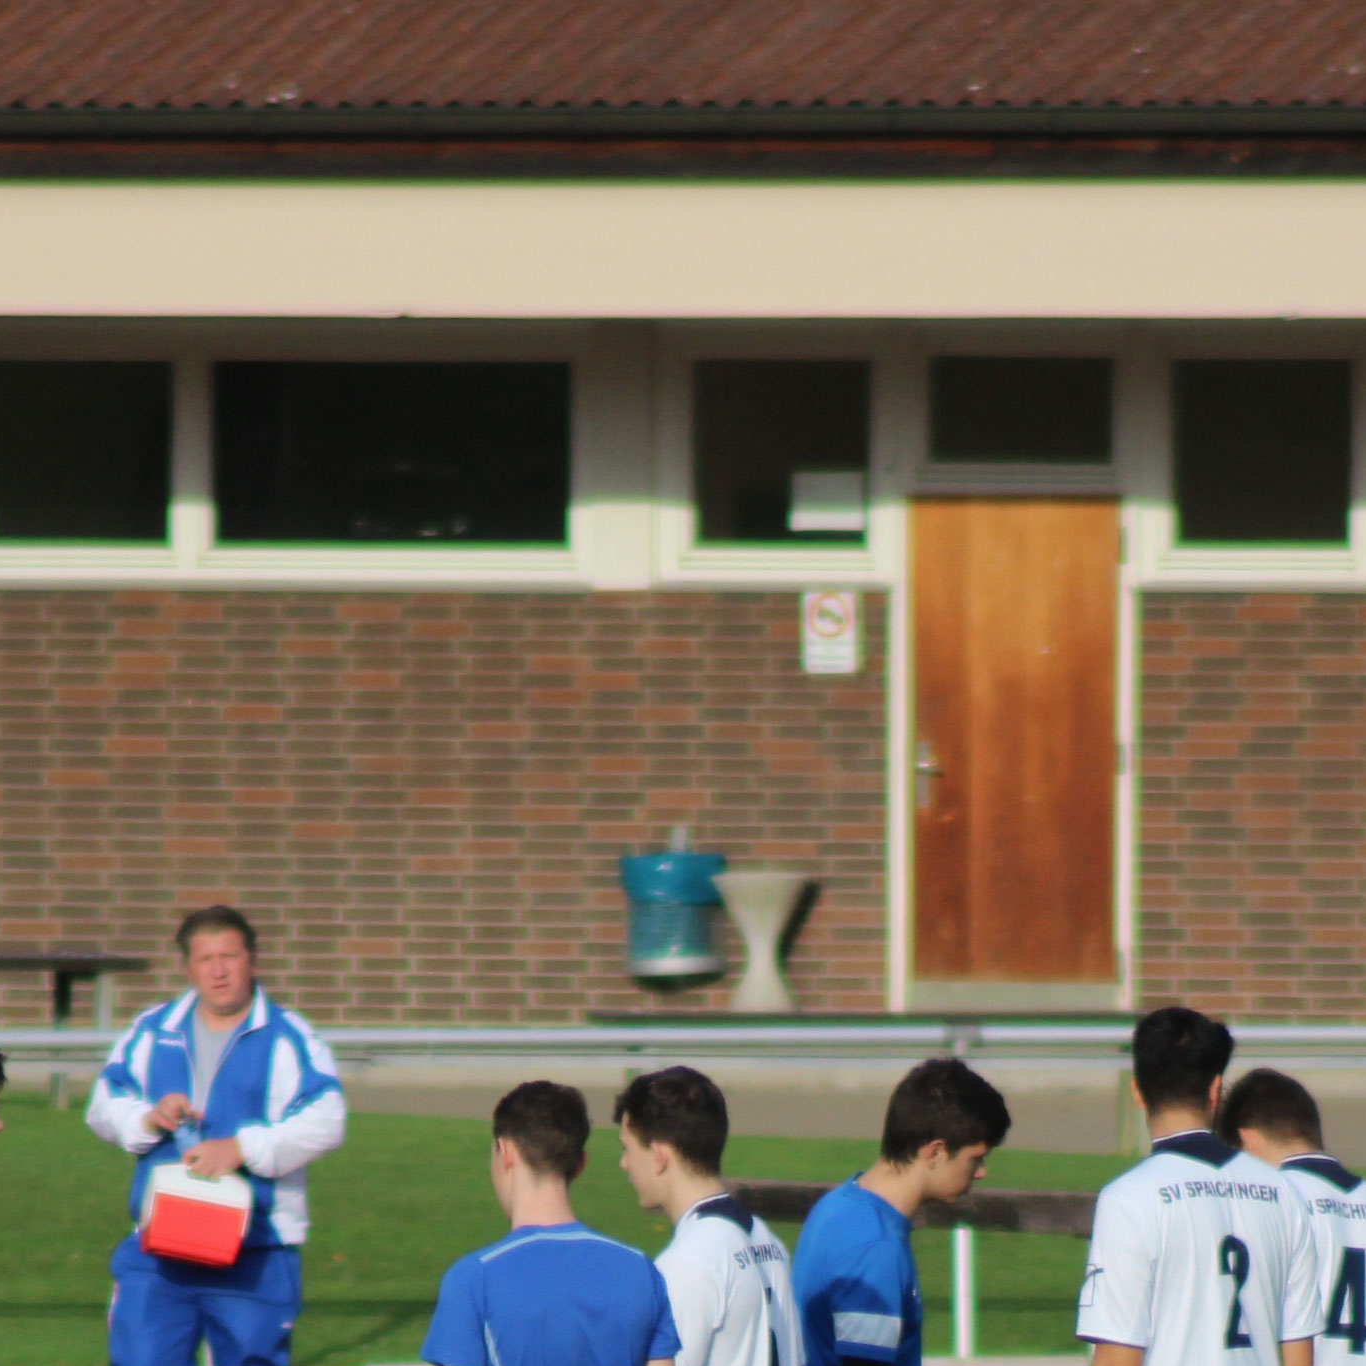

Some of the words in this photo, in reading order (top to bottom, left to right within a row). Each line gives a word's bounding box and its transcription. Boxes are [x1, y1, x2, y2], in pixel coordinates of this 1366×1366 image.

[1159, 1184, 1181, 1204] SV
[1184, 1180, 1279, 1204] SPAICHINGEN
[1219, 1234, 1253, 1349] 2
